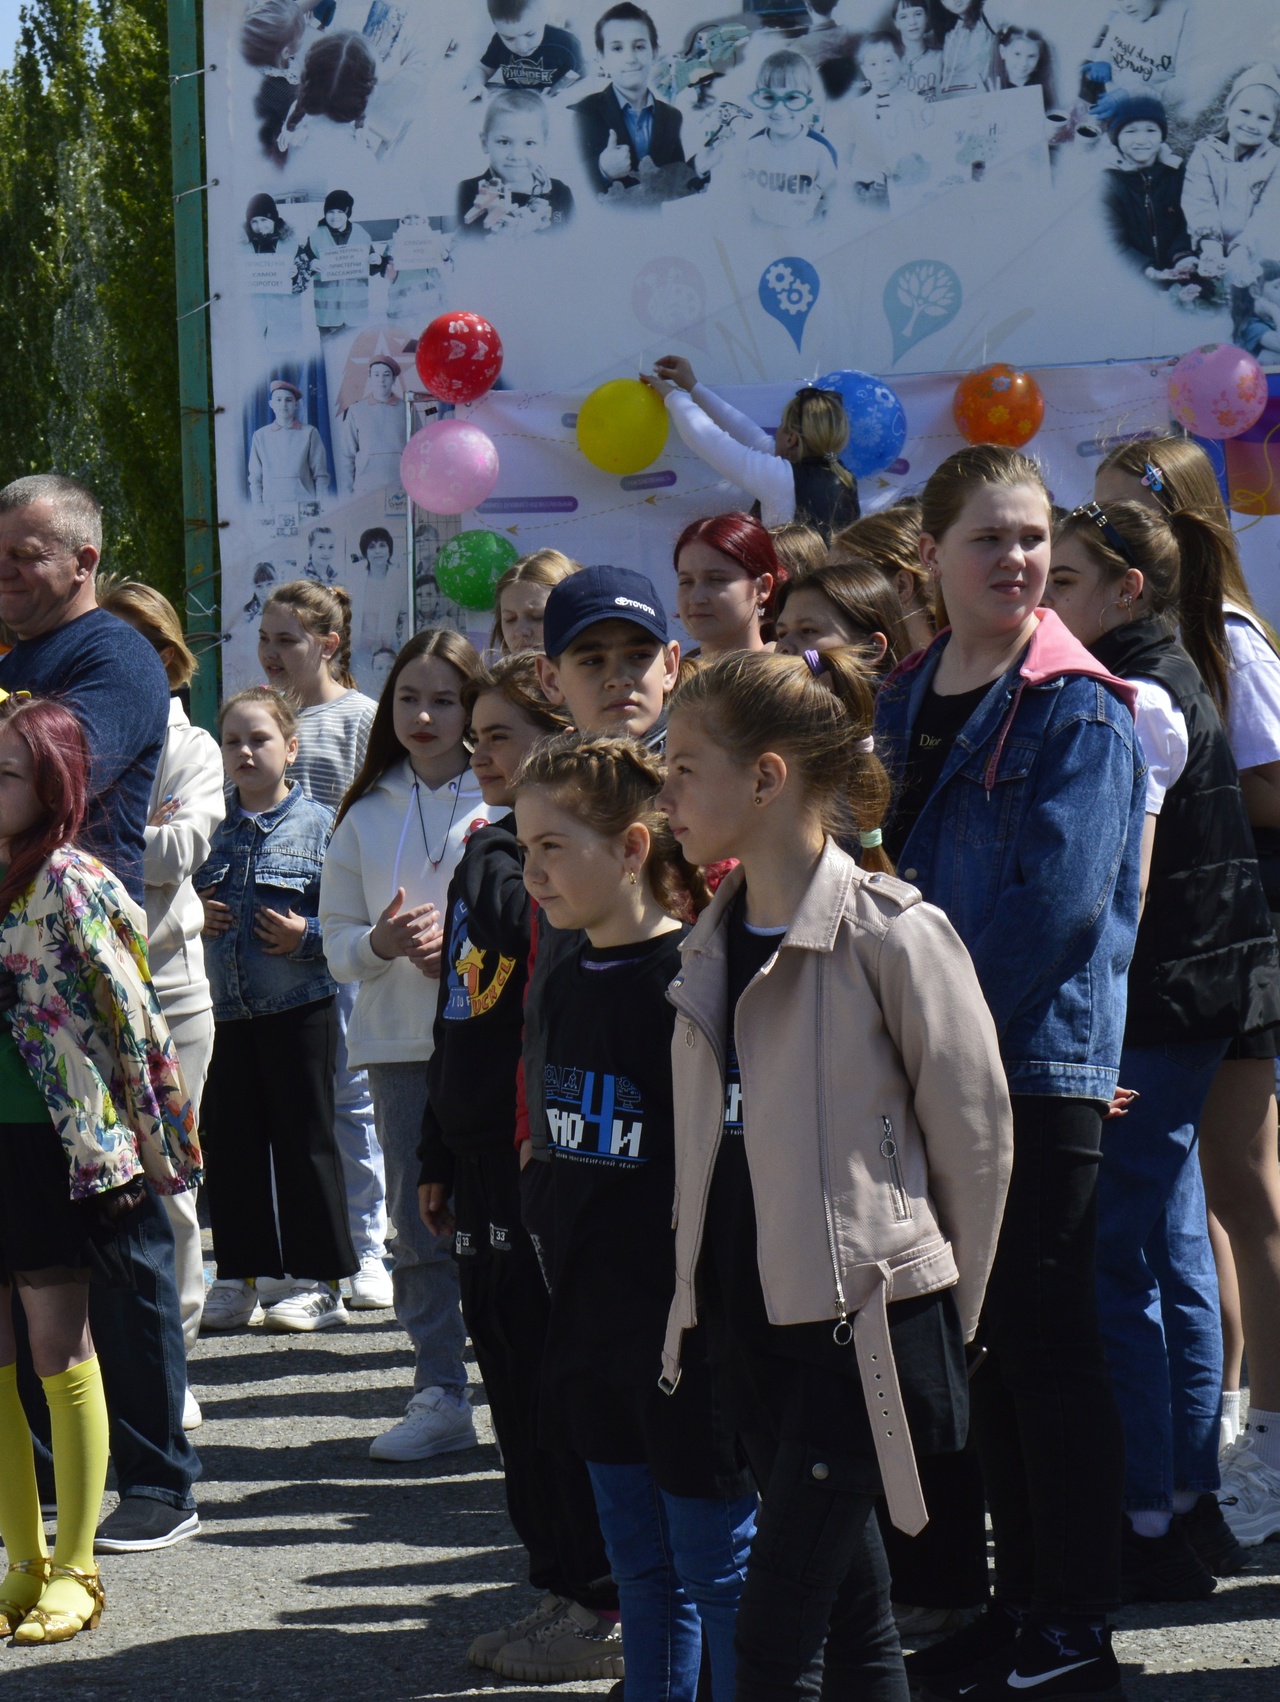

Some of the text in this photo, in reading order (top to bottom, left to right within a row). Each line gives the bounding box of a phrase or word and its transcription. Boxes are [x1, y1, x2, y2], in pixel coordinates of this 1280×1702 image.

[500, 64, 558, 84] THUNDER
[328, 261, 362, 270] ПРИСТЕГНИ
[627, 598, 656, 617] TOYOTA
[919, 733, 942, 747] Dior
